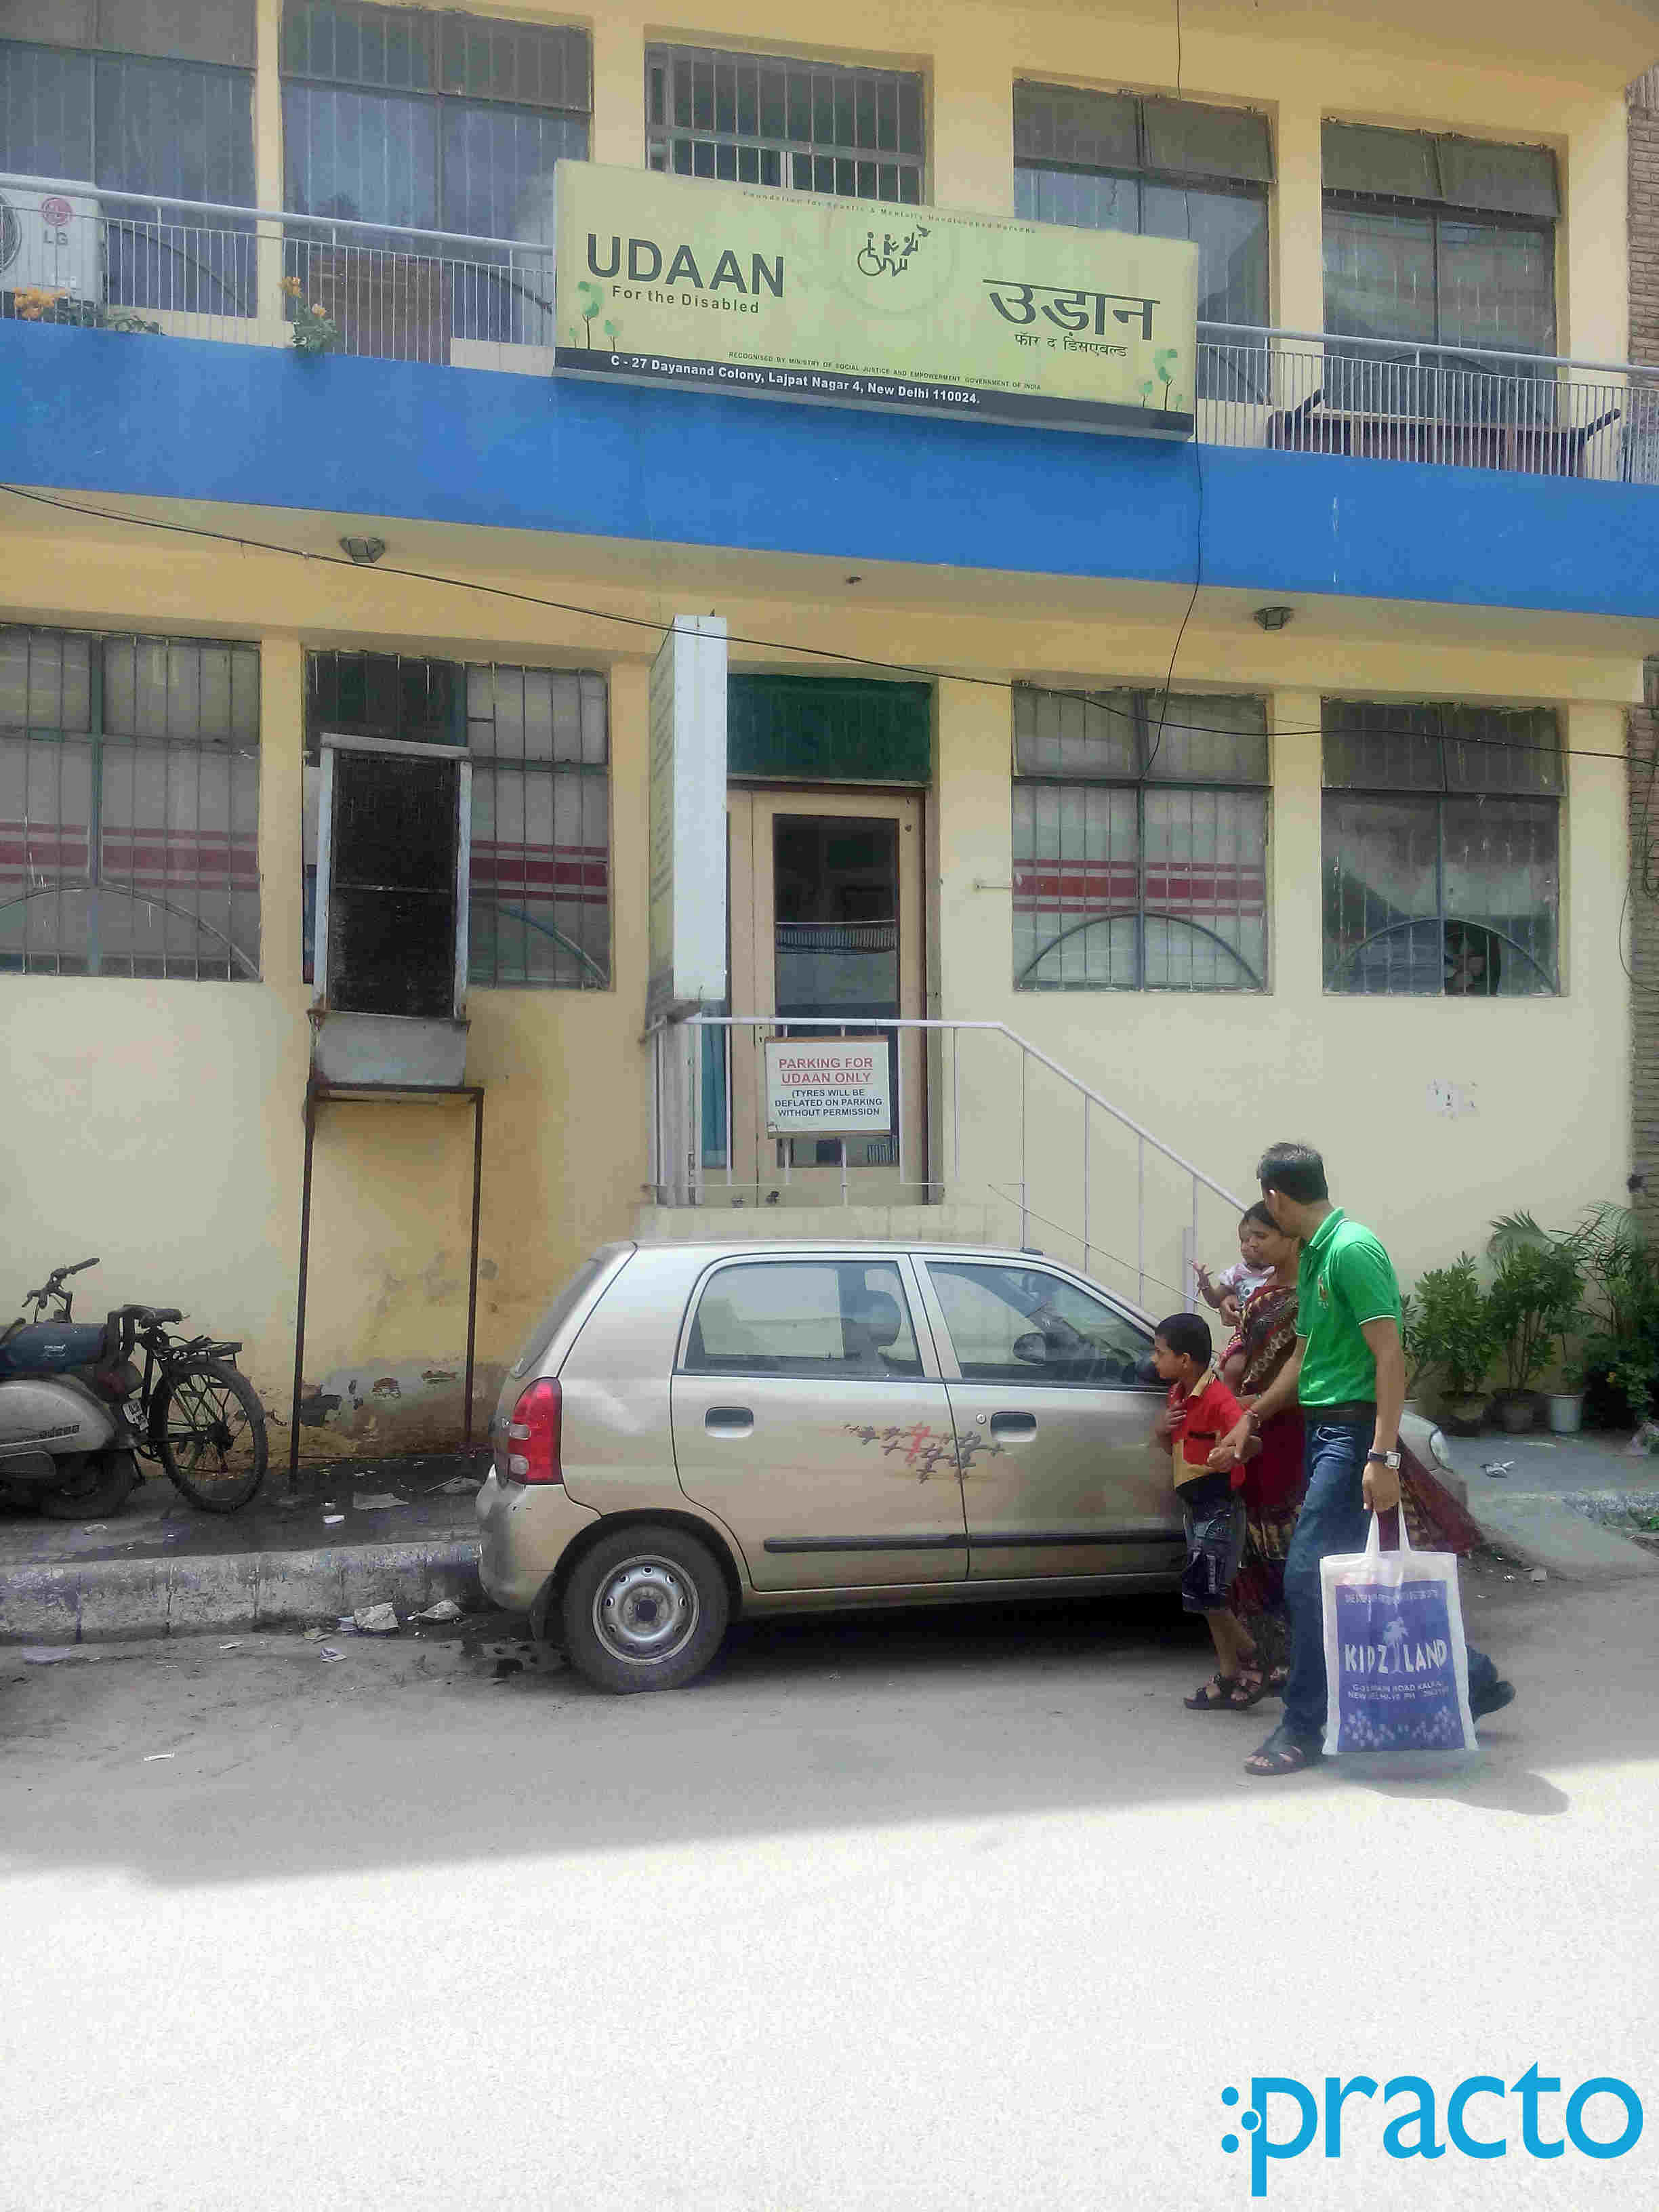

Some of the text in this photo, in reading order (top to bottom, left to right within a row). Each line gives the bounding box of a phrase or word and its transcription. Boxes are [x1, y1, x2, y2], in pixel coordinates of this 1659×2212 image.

[43, 230, 67, 245] LG
[588, 233, 784, 298] UDAAN
[612, 285, 758, 313] For the Disabled
[1046, 337, 1057, 352] द
[729, 352, 773, 363] RECOGNISED
[789, 358, 819, 367] MINISTRY
[836, 363, 859, 371] SOCIAL
[863, 367, 890, 375] JUSTICE
[893, 369, 907, 377] AND
[910, 371, 960, 382] EMPOWERMENT
[965, 377, 1008, 388] GOVERNMENT
[1024, 383, 1041, 391] INDIA
[611, 355, 620, 366] C
[632, 357, 647, 369] 27
[651, 359, 714, 376] Dayanand
[718, 367, 764, 384] Colony,
[769, 371, 808, 388] Lajpat
[812, 376, 848, 391] Nagar
[853, 381, 863, 394] 4,
[868, 382, 894, 396] New
[898, 386, 928, 399] Delhi
[933, 389, 980, 405] 110024.
[779, 1057, 873, 1069] PARKING FOR
[781, 1072, 872, 1084] UDAAN ONLY
[792, 1089, 825, 1099] (TYRES
[827, 1089, 851, 1097] WILL
[775, 1098, 882, 1107] DEFLATED ON PARKING
[778, 1108, 880, 1117] WITHOUT PERMISSION
[1404, 1639, 1448, 1672] LAND
